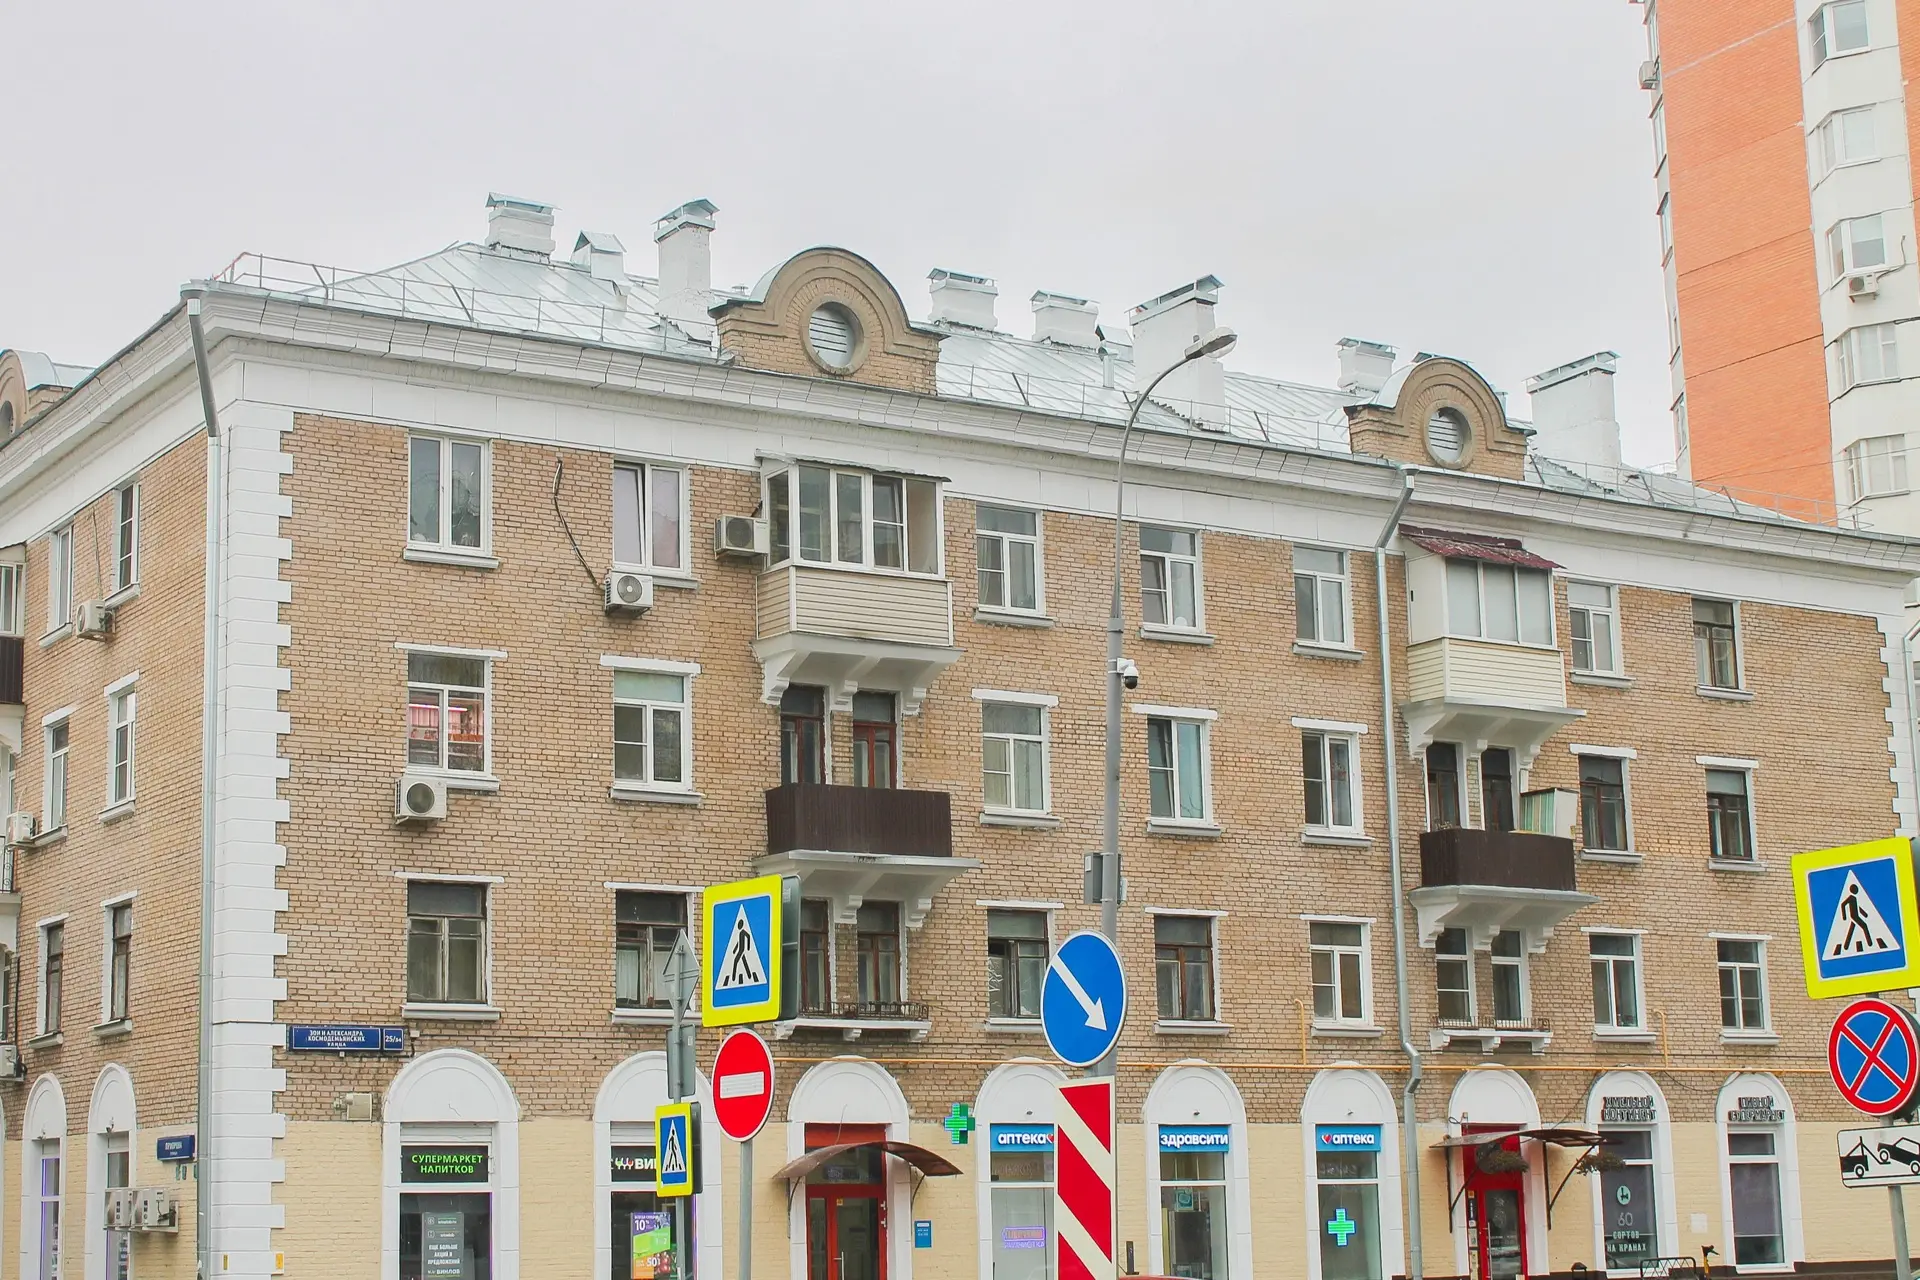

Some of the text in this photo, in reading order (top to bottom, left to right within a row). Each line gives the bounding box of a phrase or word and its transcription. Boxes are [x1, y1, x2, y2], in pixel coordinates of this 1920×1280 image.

[1603, 1095, 1654, 1108] ХМЕЛЬНОЙ
[1738, 1095, 1774, 1108] ПИВНОЙ
[1601, 1108, 1656, 1121] КОНТИНЕНТ
[1728, 1108, 1785, 1121] СУПЕРМАРКЕТ
[998, 1133, 1046, 1145] аптека
[1160, 1134, 1228, 1148] здравсити
[1332, 1134, 1375, 1144] аптека
[411, 1154, 483, 1163] СУПЕРМАРКЕТ
[420, 1165, 474, 1174] НАПИТКОВ
[1618, 1212, 1633, 1226] 60
[1612, 1230, 1640, 1240] СОРТОВ
[1607, 1243, 1647, 1252] НА КРАНАХ
